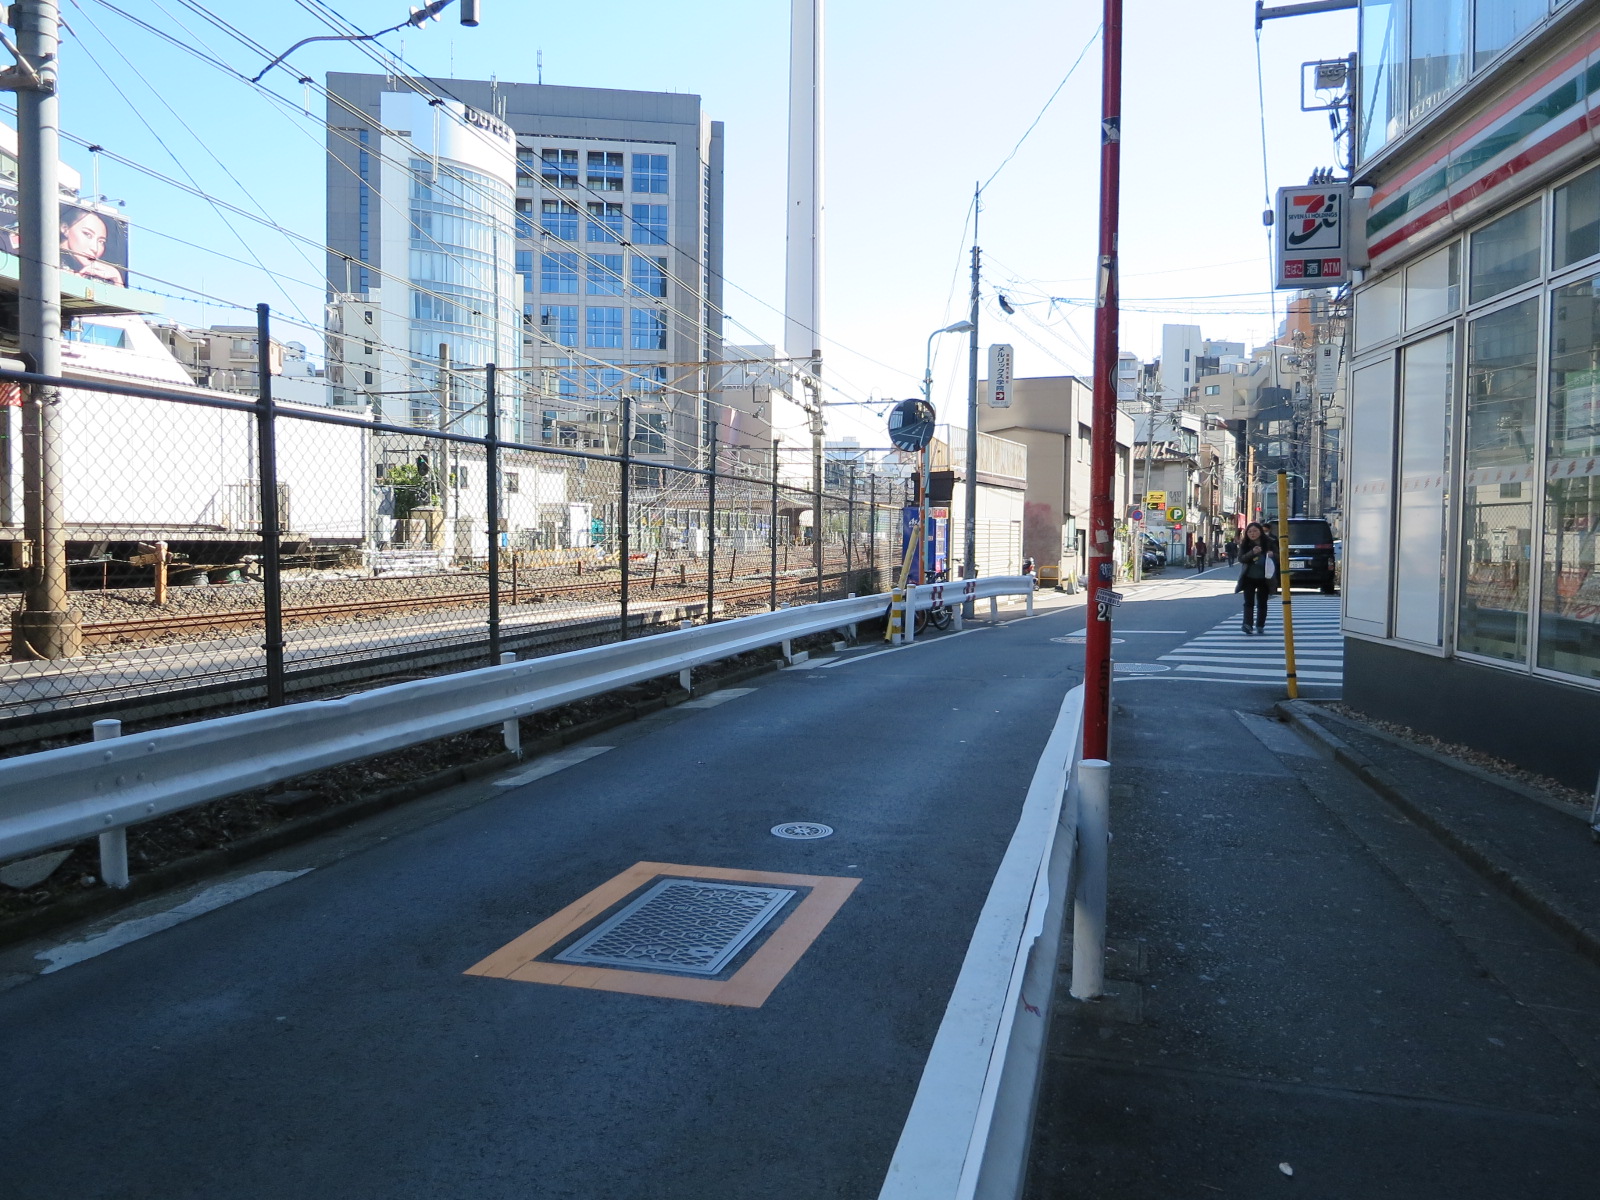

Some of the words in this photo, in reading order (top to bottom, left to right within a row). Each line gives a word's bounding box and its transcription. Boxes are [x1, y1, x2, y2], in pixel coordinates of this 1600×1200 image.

[1306, 263, 1319, 275] 酒
[1323, 262, 1341, 274] ATM
[996, 346, 1005, 391] メルリックス学院
[1174, 509, 1182, 519] P
